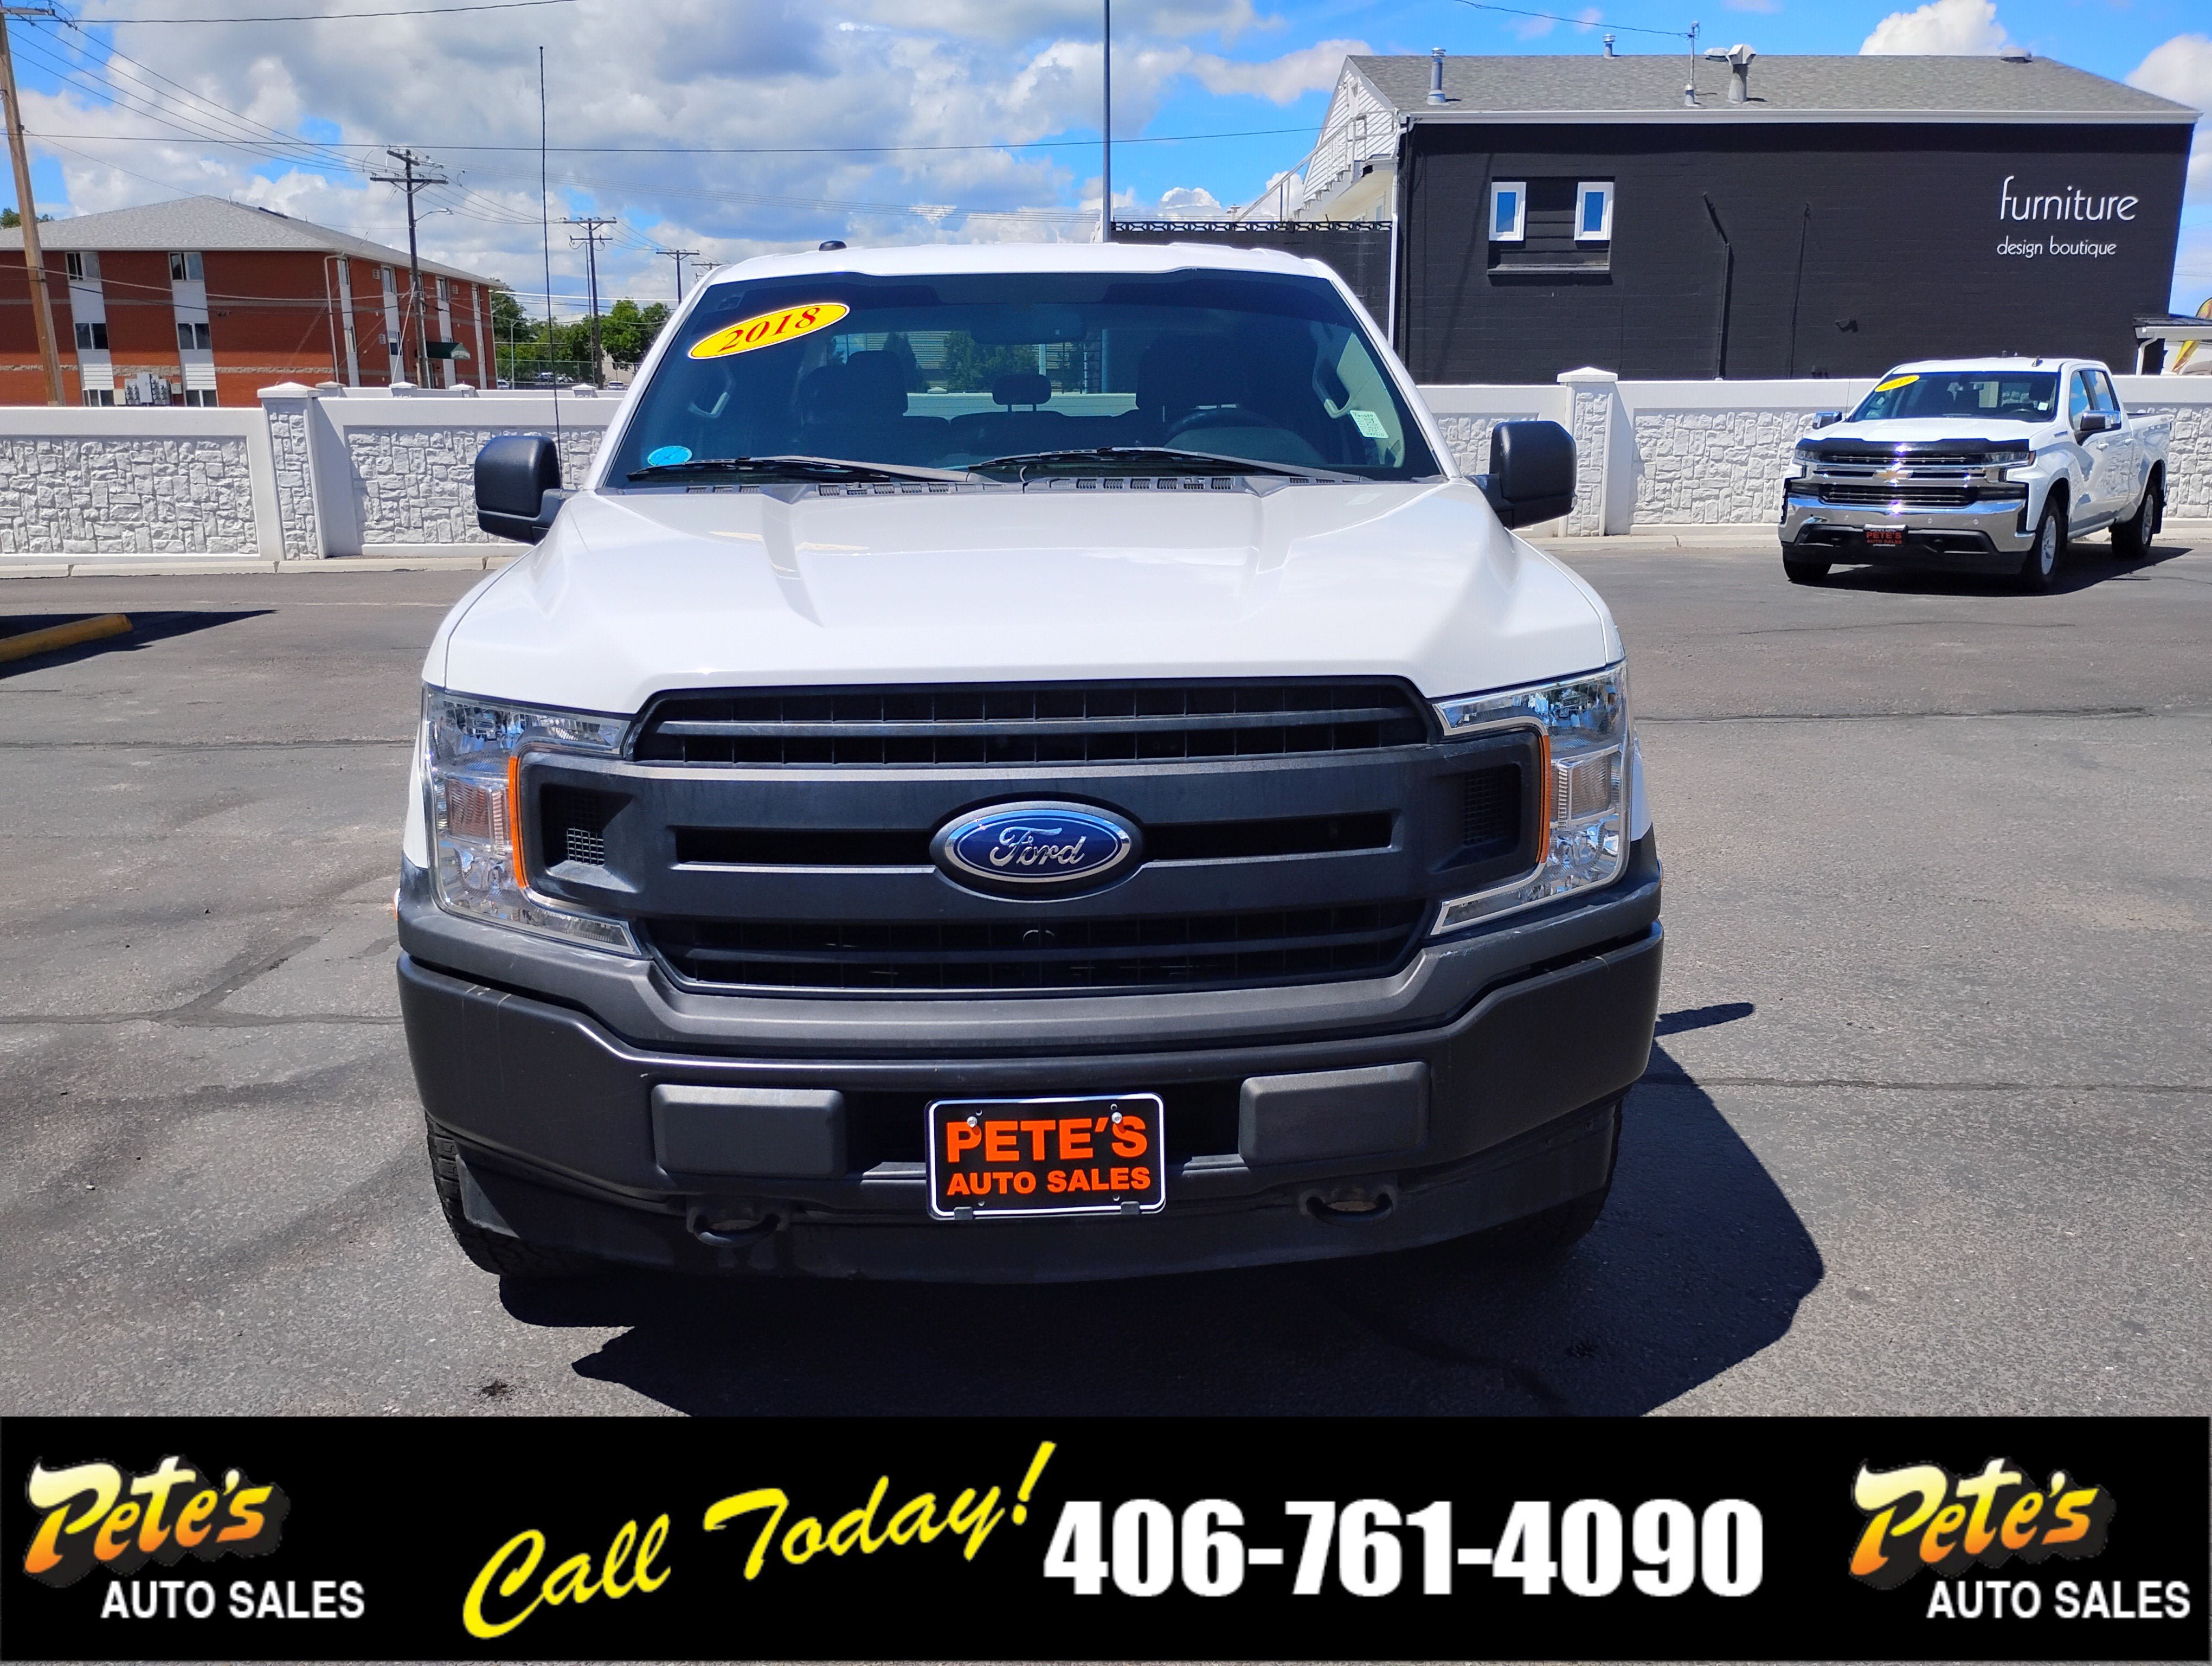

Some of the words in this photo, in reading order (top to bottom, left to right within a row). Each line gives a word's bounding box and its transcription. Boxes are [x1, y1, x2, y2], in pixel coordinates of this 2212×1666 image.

[2000, 175, 2139, 221] furniture
[1996, 235, 2043, 258] design
[2049, 235, 2117, 258] boutique
[717, 307, 820, 353] 2018
[989, 826, 1087, 867] Ford
[947, 1115, 1148, 1163] PETE'S
[947, 1171, 1036, 1196] AUTO
[1047, 1167, 1151, 1193] SALES
